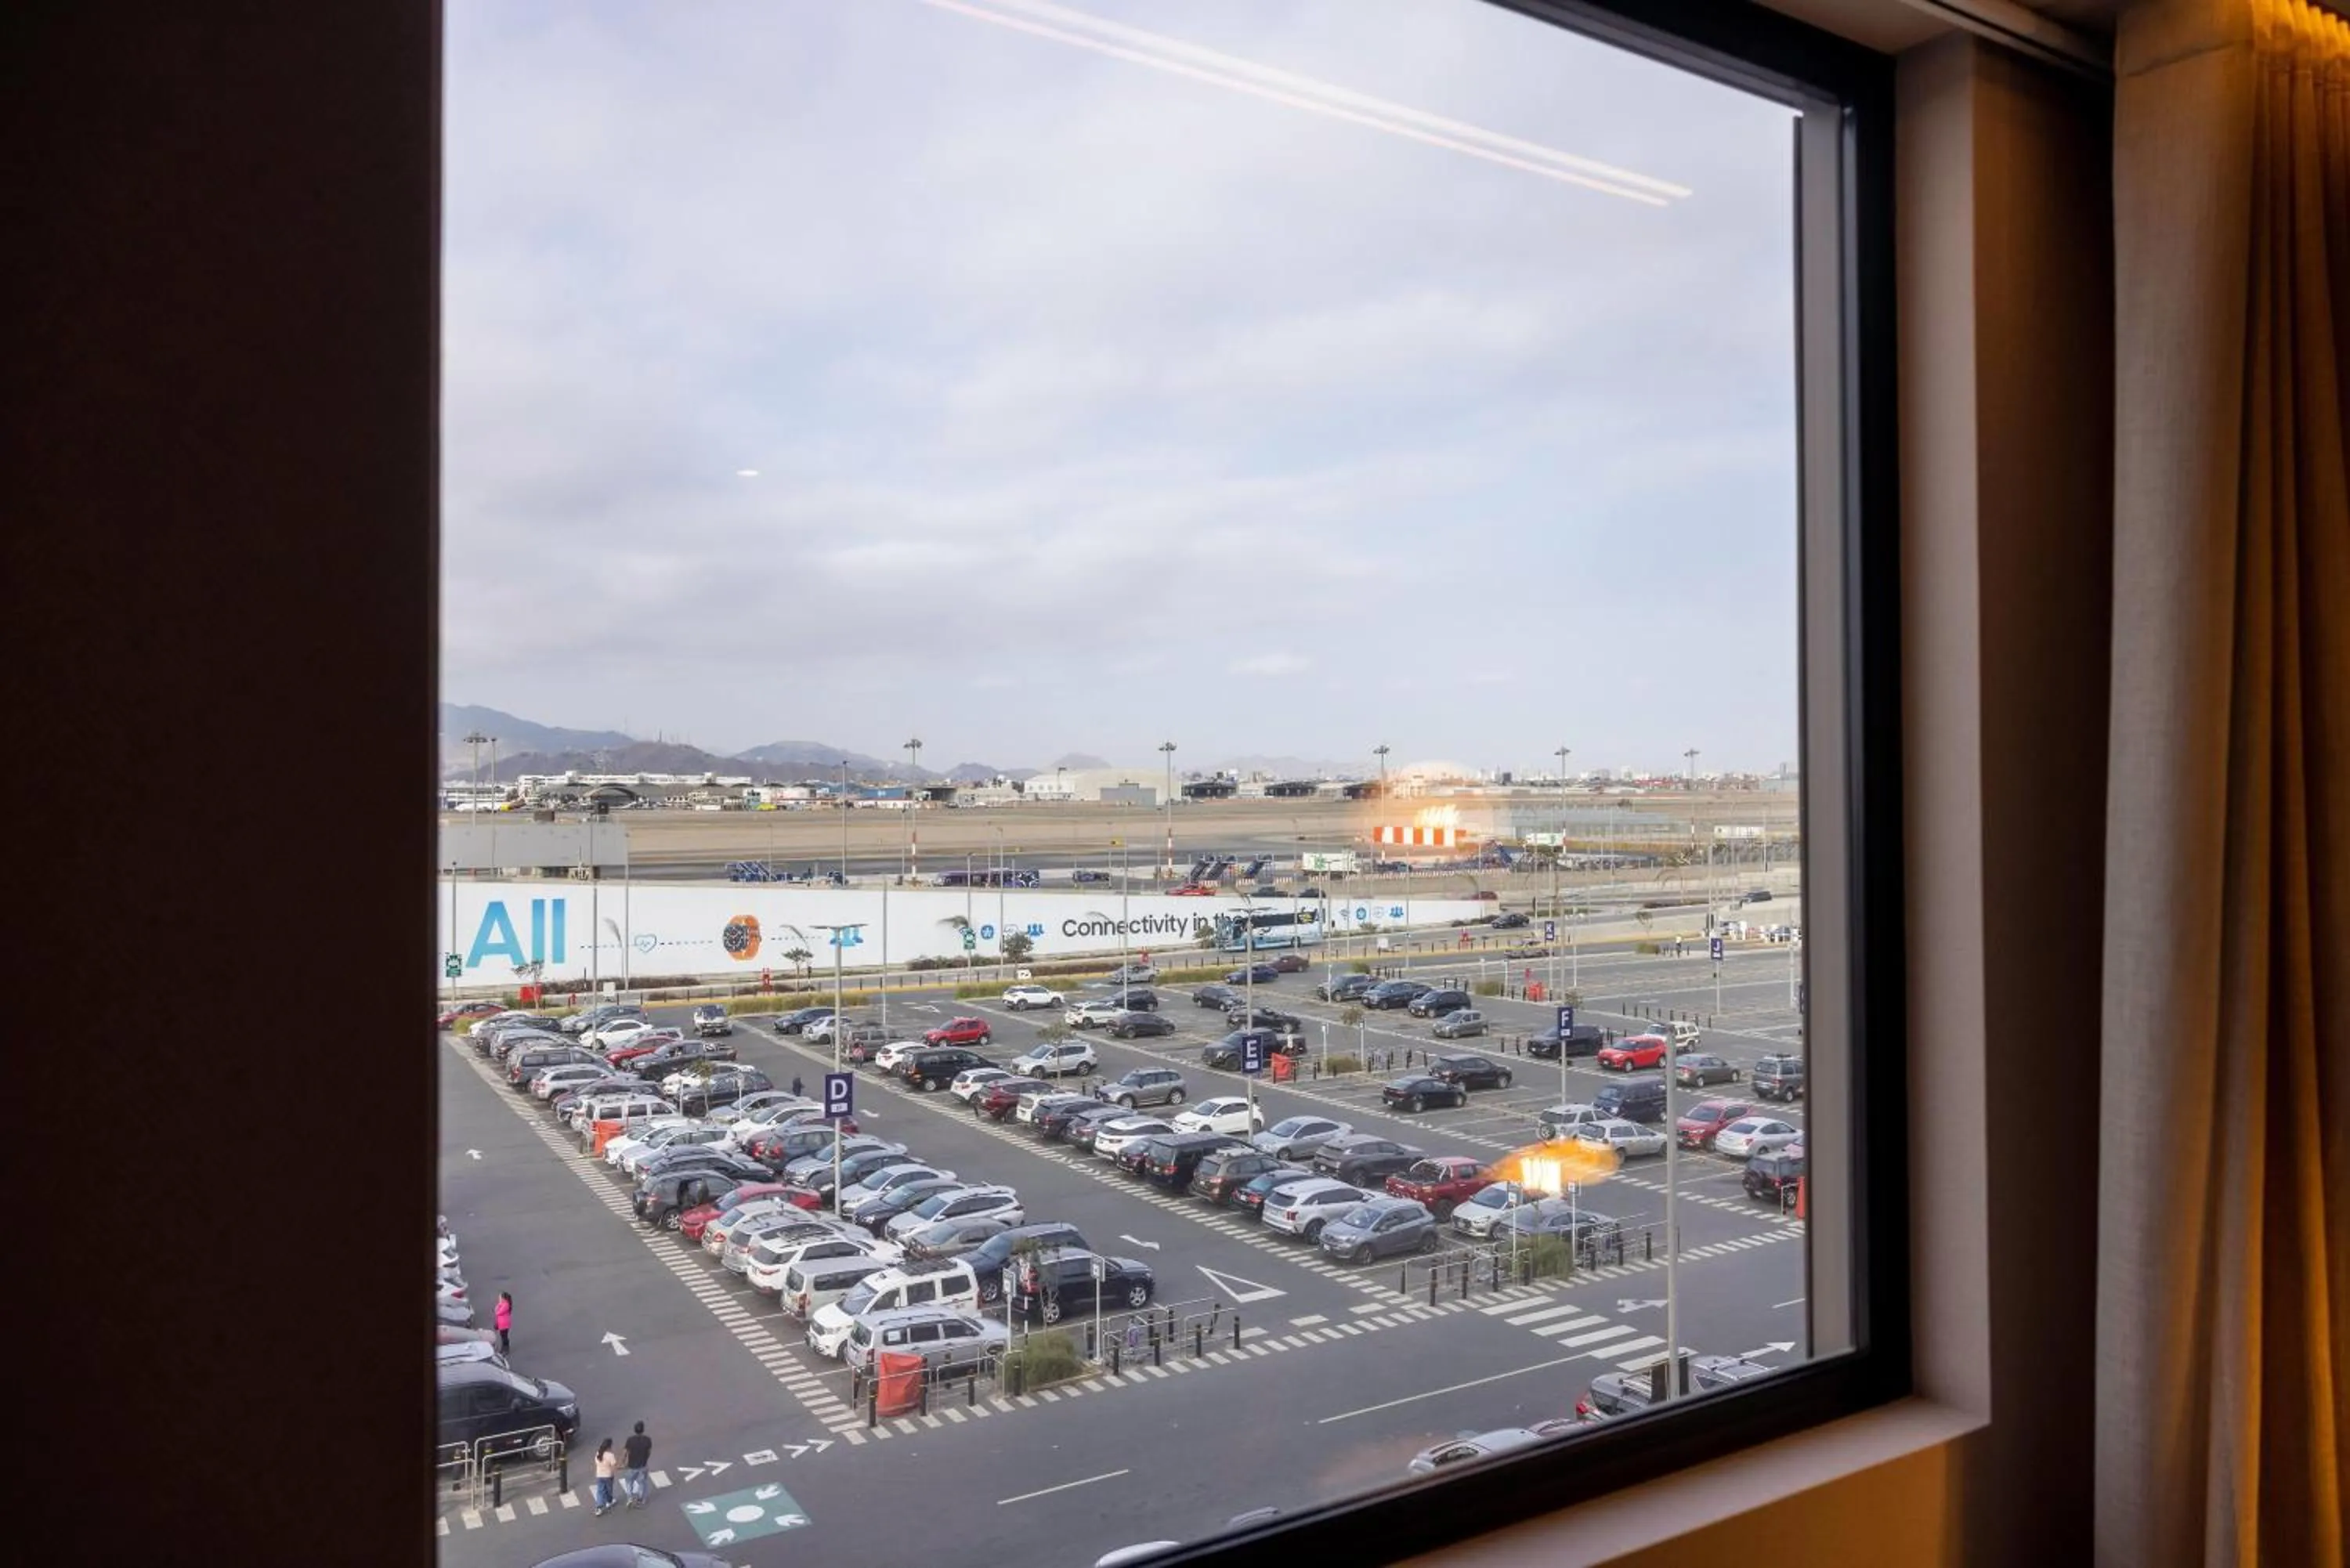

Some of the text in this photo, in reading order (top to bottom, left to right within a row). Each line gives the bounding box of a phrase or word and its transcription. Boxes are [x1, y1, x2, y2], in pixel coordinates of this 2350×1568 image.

[465, 898, 565, 967] All
[1061, 912, 1188, 938] Connectivity
[1193, 912, 1209, 930] in
[1713, 940, 1721, 952] J
[1561, 1010, 1570, 1028] F
[1246, 1039, 1257, 1058] E
[830, 1078, 848, 1100] D
